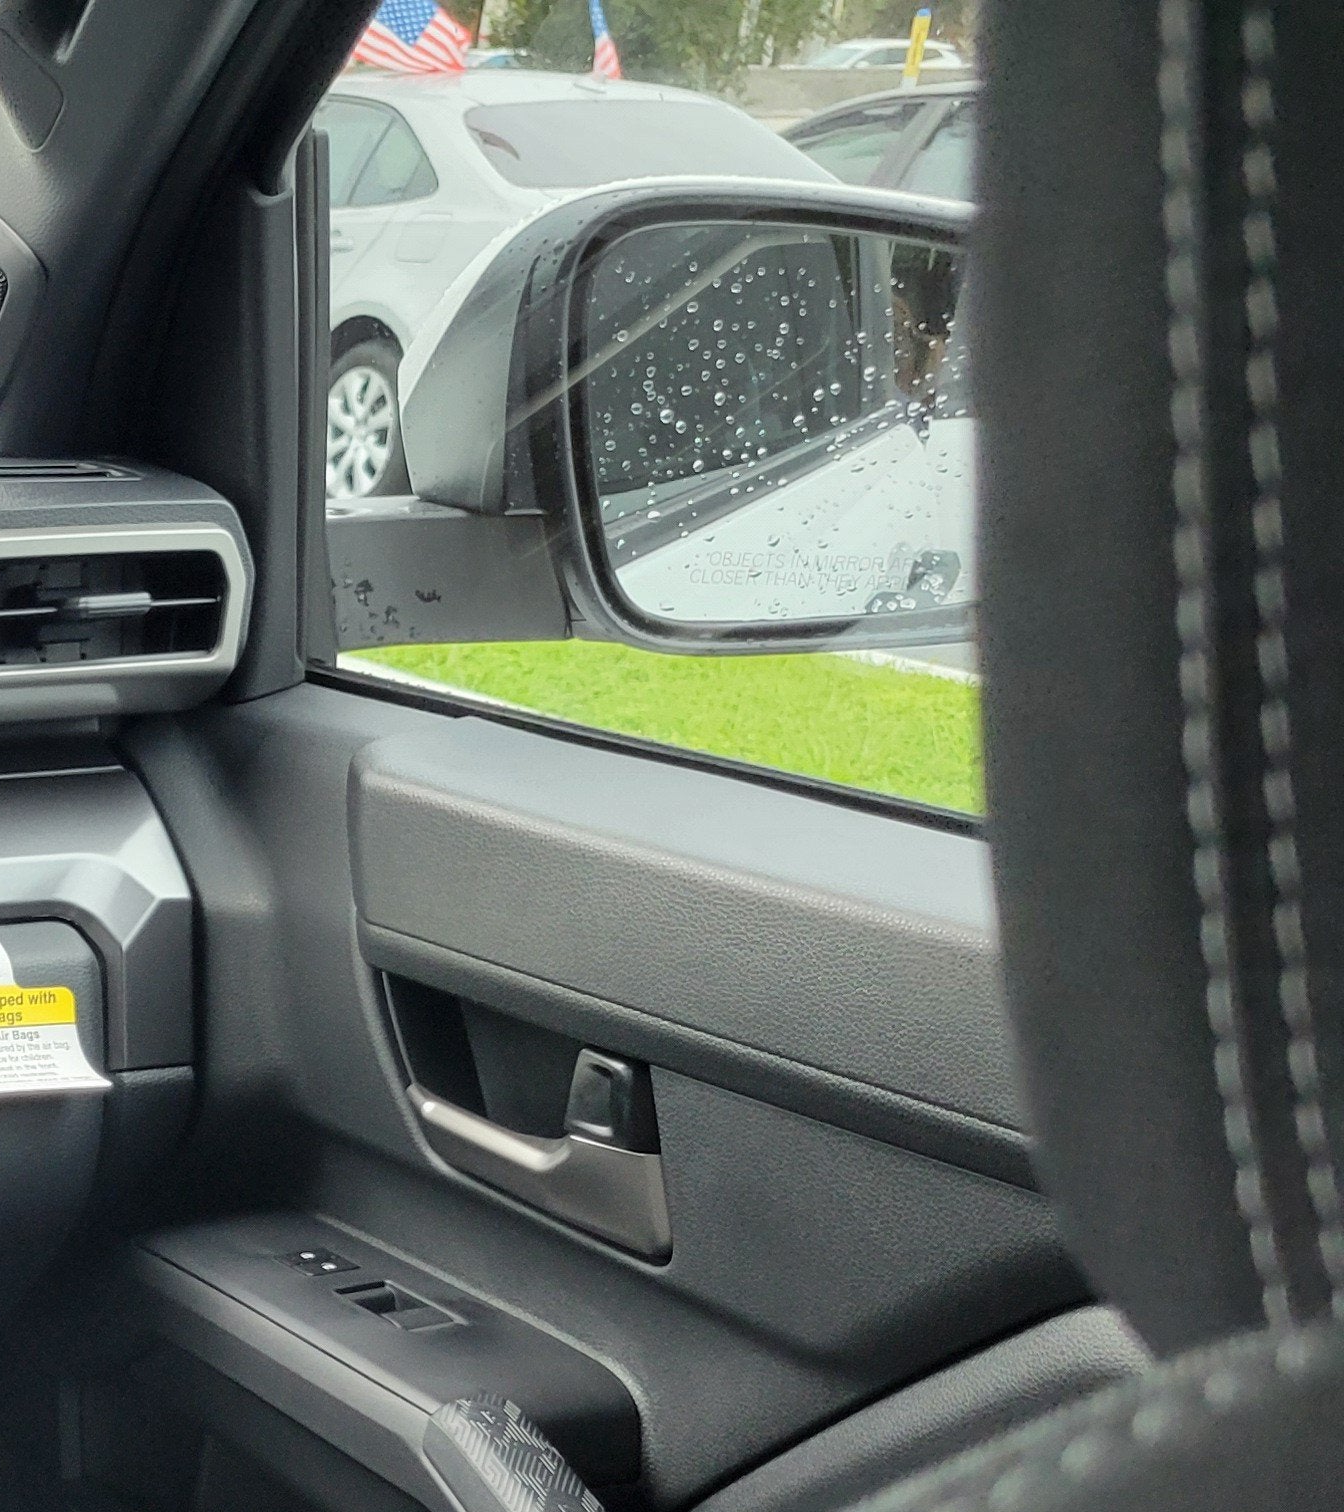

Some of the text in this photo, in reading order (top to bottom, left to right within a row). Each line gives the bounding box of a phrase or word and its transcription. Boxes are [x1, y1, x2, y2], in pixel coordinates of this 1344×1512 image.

[791, 552, 812, 568] IN
[814, 553, 885, 571] MIRROR
[689, 569, 758, 585] CLOSER
[764, 571, 810, 586] THAN
[818, 571, 861, 588] THEY
[28, 991, 57, 1005] with
[12, 1029, 40, 1042] Bags
[16, 1043, 25, 1052] by
[27, 1042, 40, 1050] the
[42, 1041, 52, 1049] air
